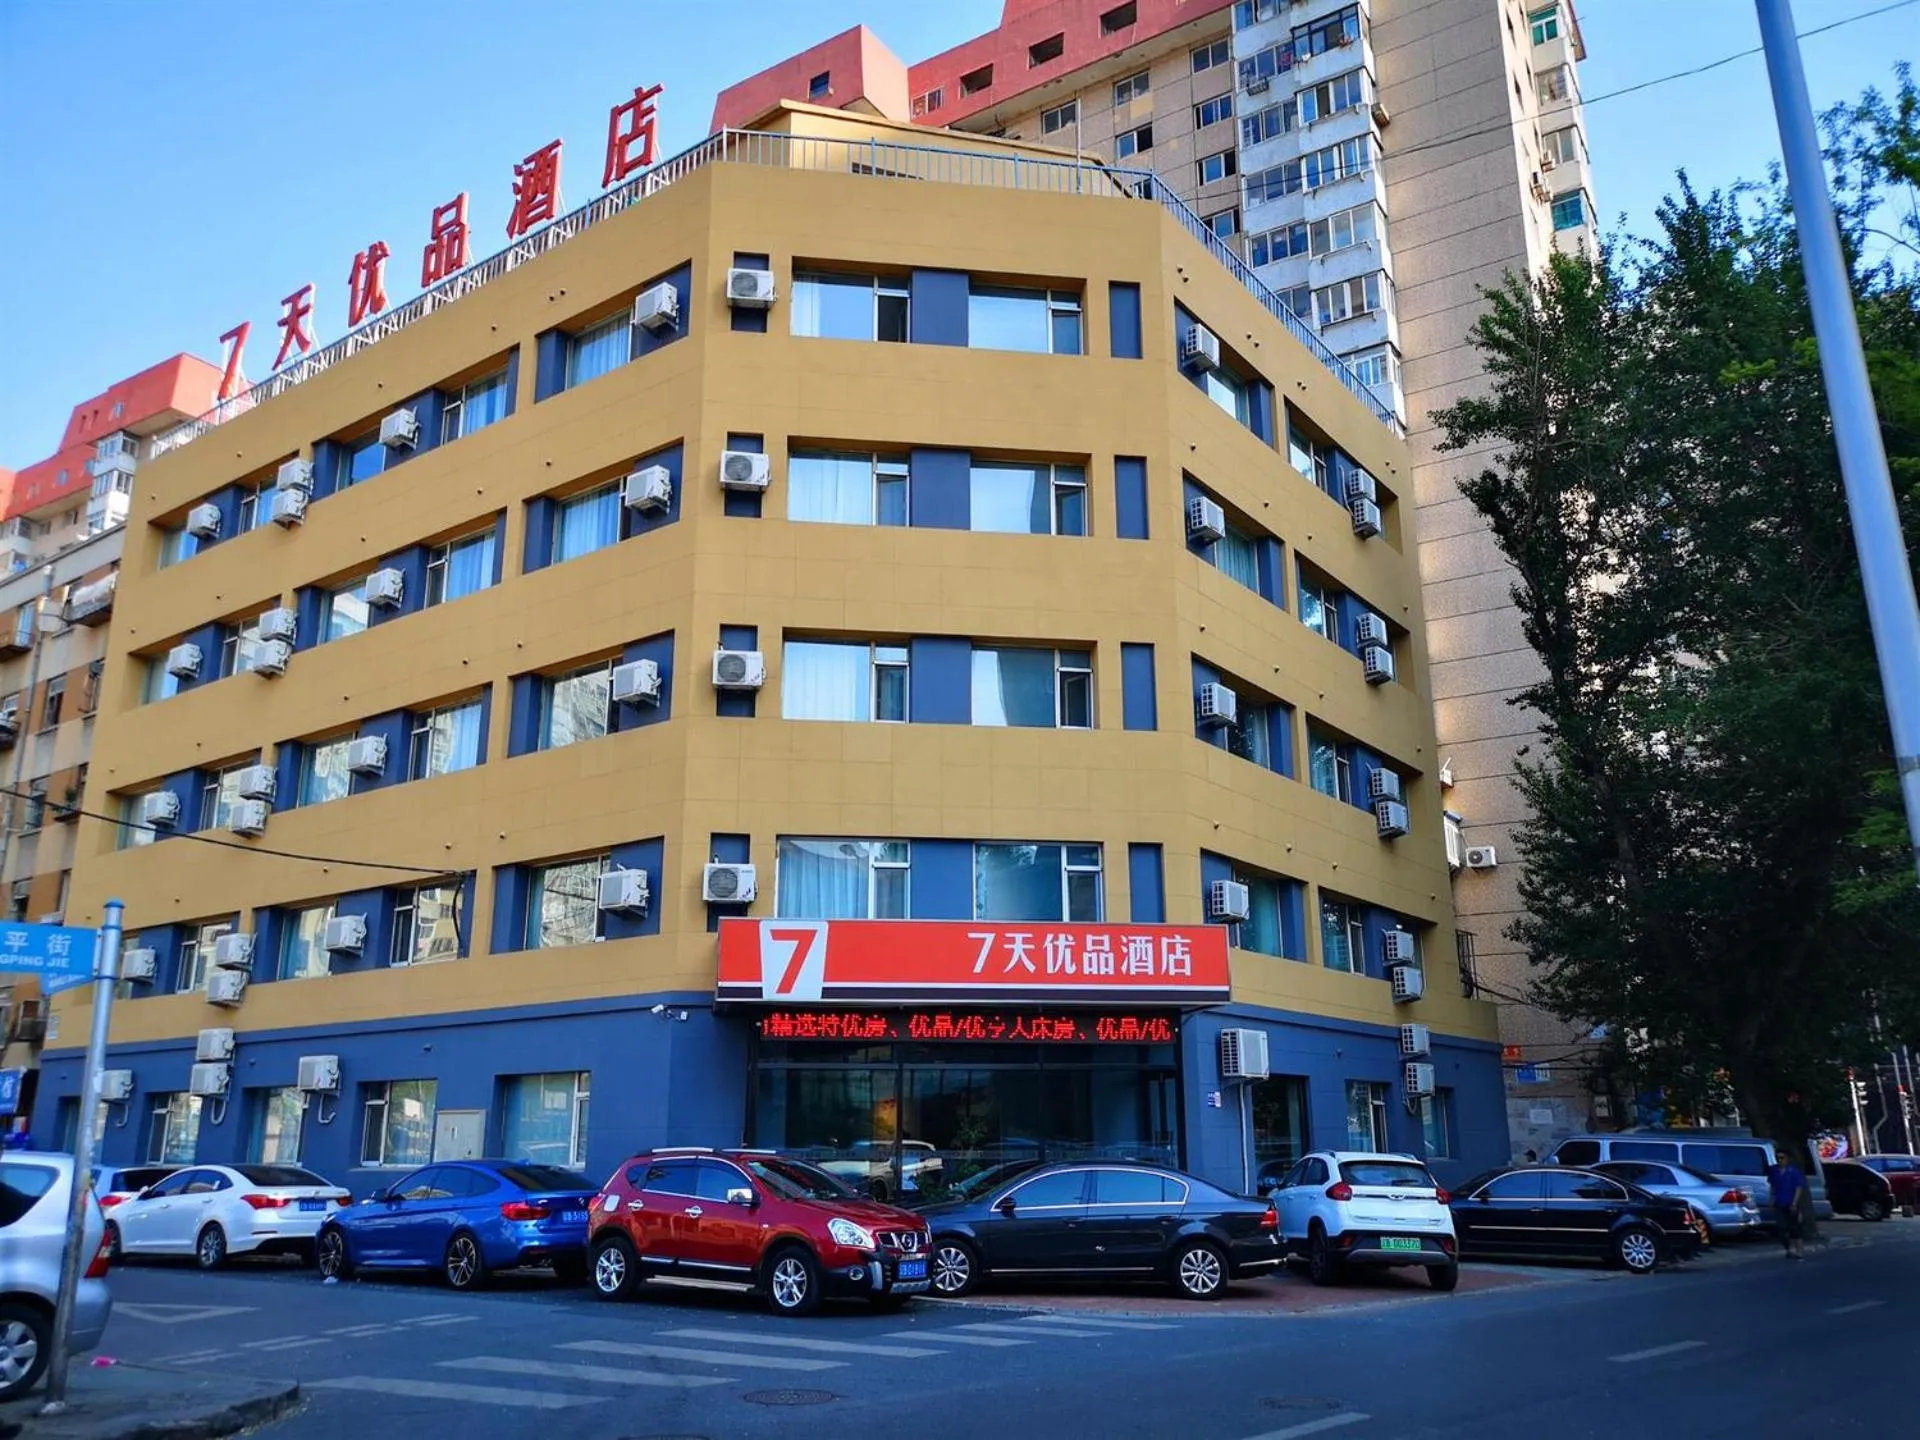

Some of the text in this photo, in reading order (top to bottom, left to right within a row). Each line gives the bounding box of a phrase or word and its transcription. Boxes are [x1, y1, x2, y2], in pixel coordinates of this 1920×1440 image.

[218, 82, 664, 400] 7天优品酒店
[46, 957, 70, 968] JIE
[769, 929, 818, 994] 7
[967, 931, 1193, 977] 7天优品酒店
